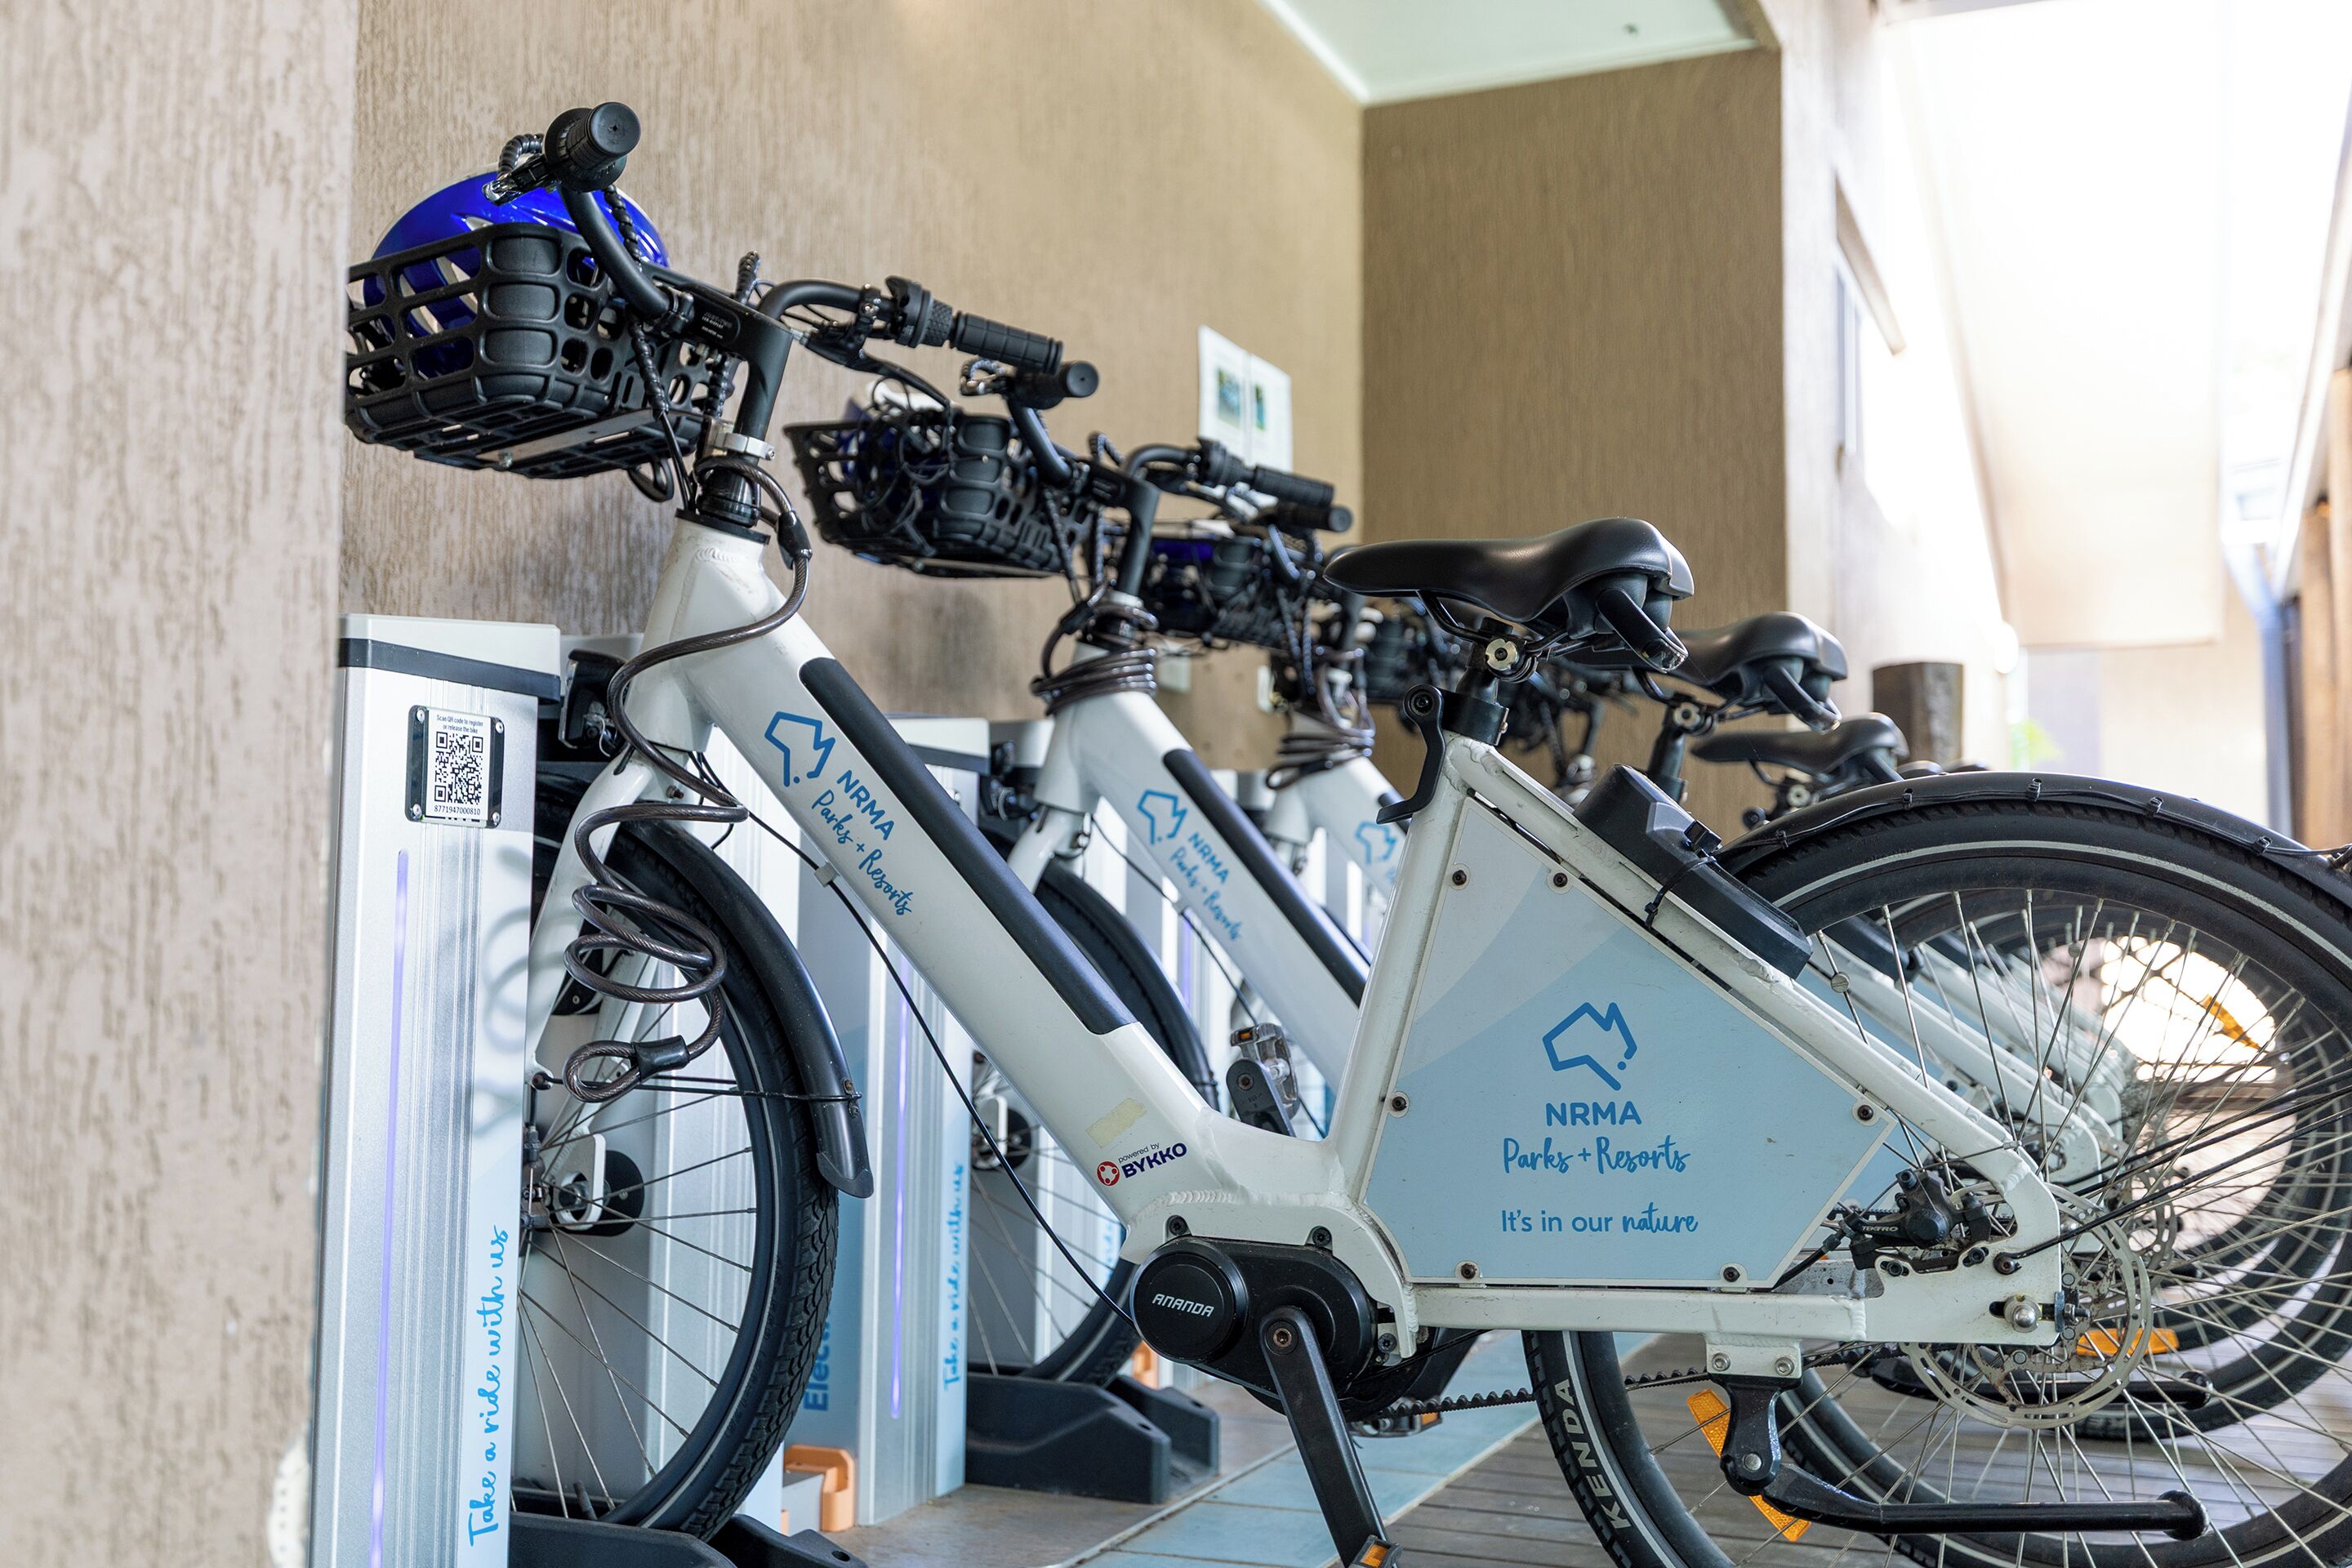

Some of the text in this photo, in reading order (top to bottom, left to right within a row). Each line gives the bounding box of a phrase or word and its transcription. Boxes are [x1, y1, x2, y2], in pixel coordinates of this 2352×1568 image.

[436, 714, 447, 722] Scan
[434, 804, 481, 816] 8771947000810
[837, 769, 895, 840] NRMA
[811, 789, 913, 915] Parks + Resorts
[1187, 831, 1230, 884] NRMA
[1546, 1101, 1642, 1126] NRMA
[1118, 1143, 1160, 1165] powered by
[1121, 1142, 1187, 1179] BYKKO
[1503, 1135, 1691, 1174] Parks + Resorts
[946, 1195, 962, 1256] with
[1501, 1202, 1699, 1234] It’s in our nature
[947, 1259, 961, 1311] ride
[1152, 1293, 1214, 1317] ANANDA
[469, 1225, 509, 1547] Take a ride with us
[942, 1337, 960, 1392] Take
[1554, 1379, 1633, 1530] KENDA
